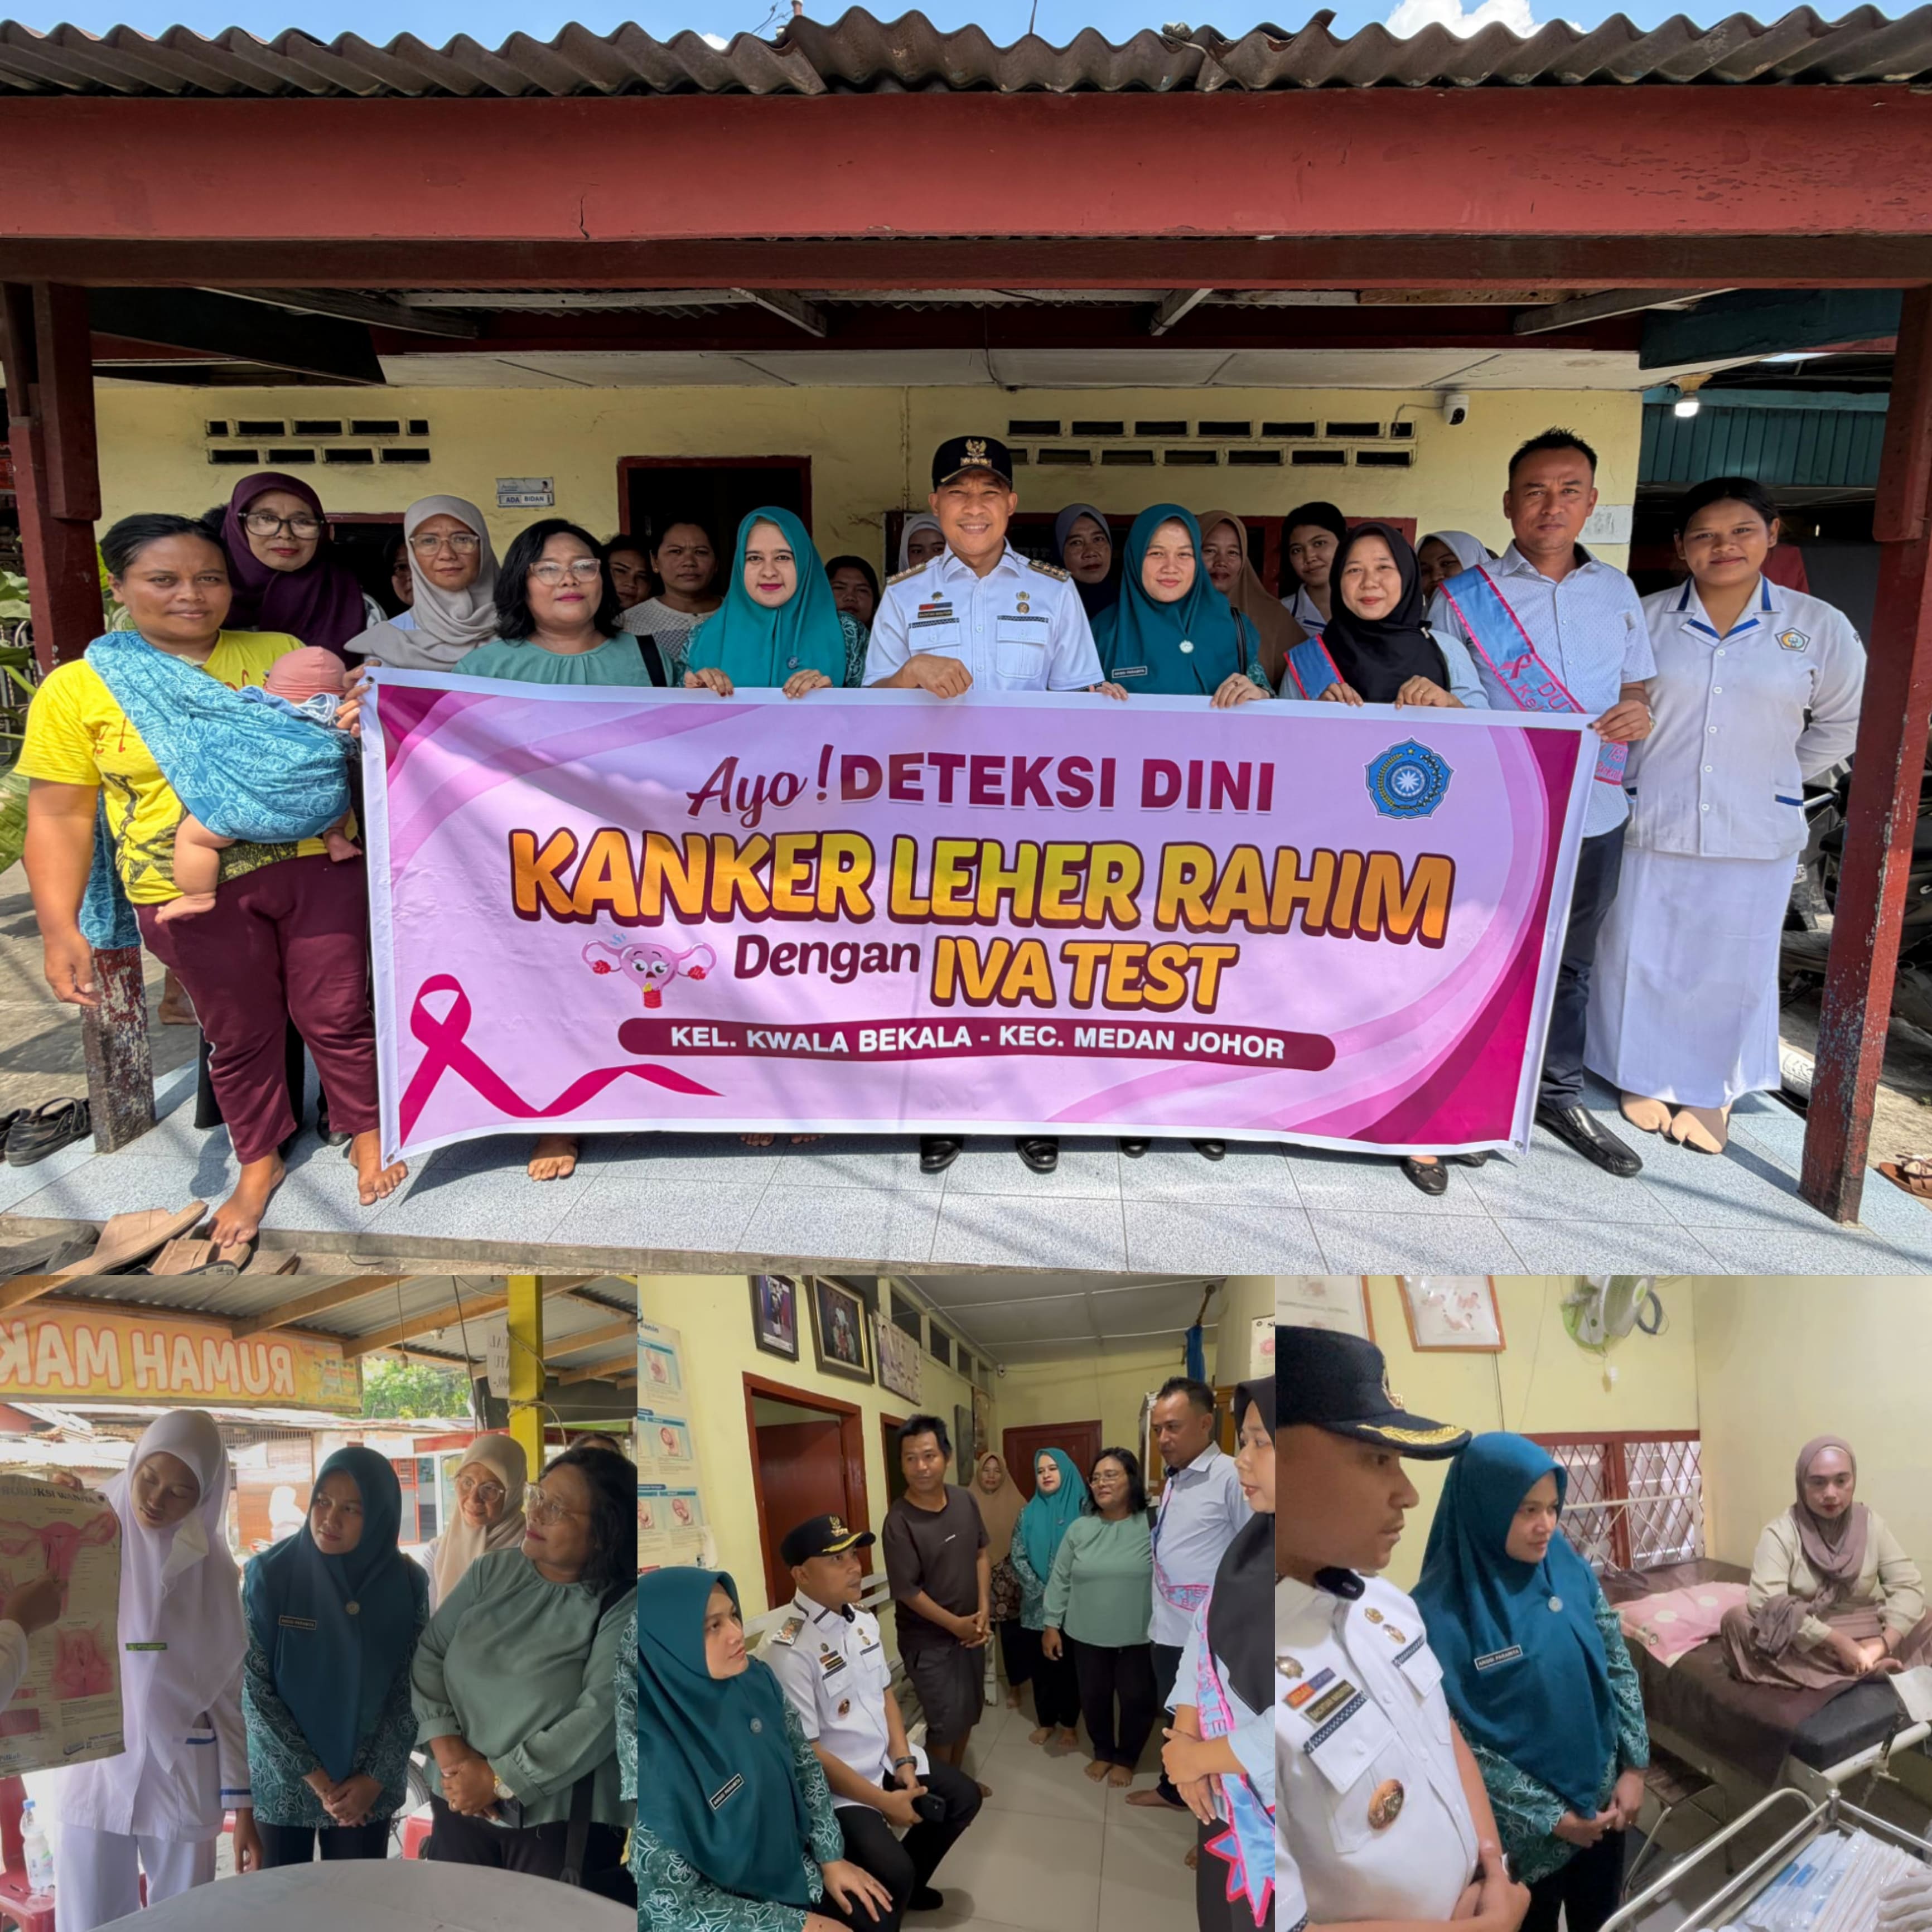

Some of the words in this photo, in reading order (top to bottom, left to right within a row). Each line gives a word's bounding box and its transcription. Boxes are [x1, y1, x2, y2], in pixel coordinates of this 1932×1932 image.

[839, 752, 1112, 810] DETEKSI
[1140, 760, 1276, 813] DINI
[509, 828, 876, 927] KANKER
[888, 835, 1143, 930] LEHER
[1156, 841, 1455, 948] RAHIM
[734, 934, 920, 984] Dengan
[930, 935, 1055, 1008] IVA
[1061, 939, 1239, 1015] TEST
[670, 1025, 737, 1049] KEL.
[746, 1027, 848, 1054] KWALA
[859, 1024, 973, 1052] BEKALA
[998, 1024, 1065, 1047] KEC.
[1074, 1026, 1175, 1051] MEDAN
[1182, 1031, 1286, 1061] JOHOR
